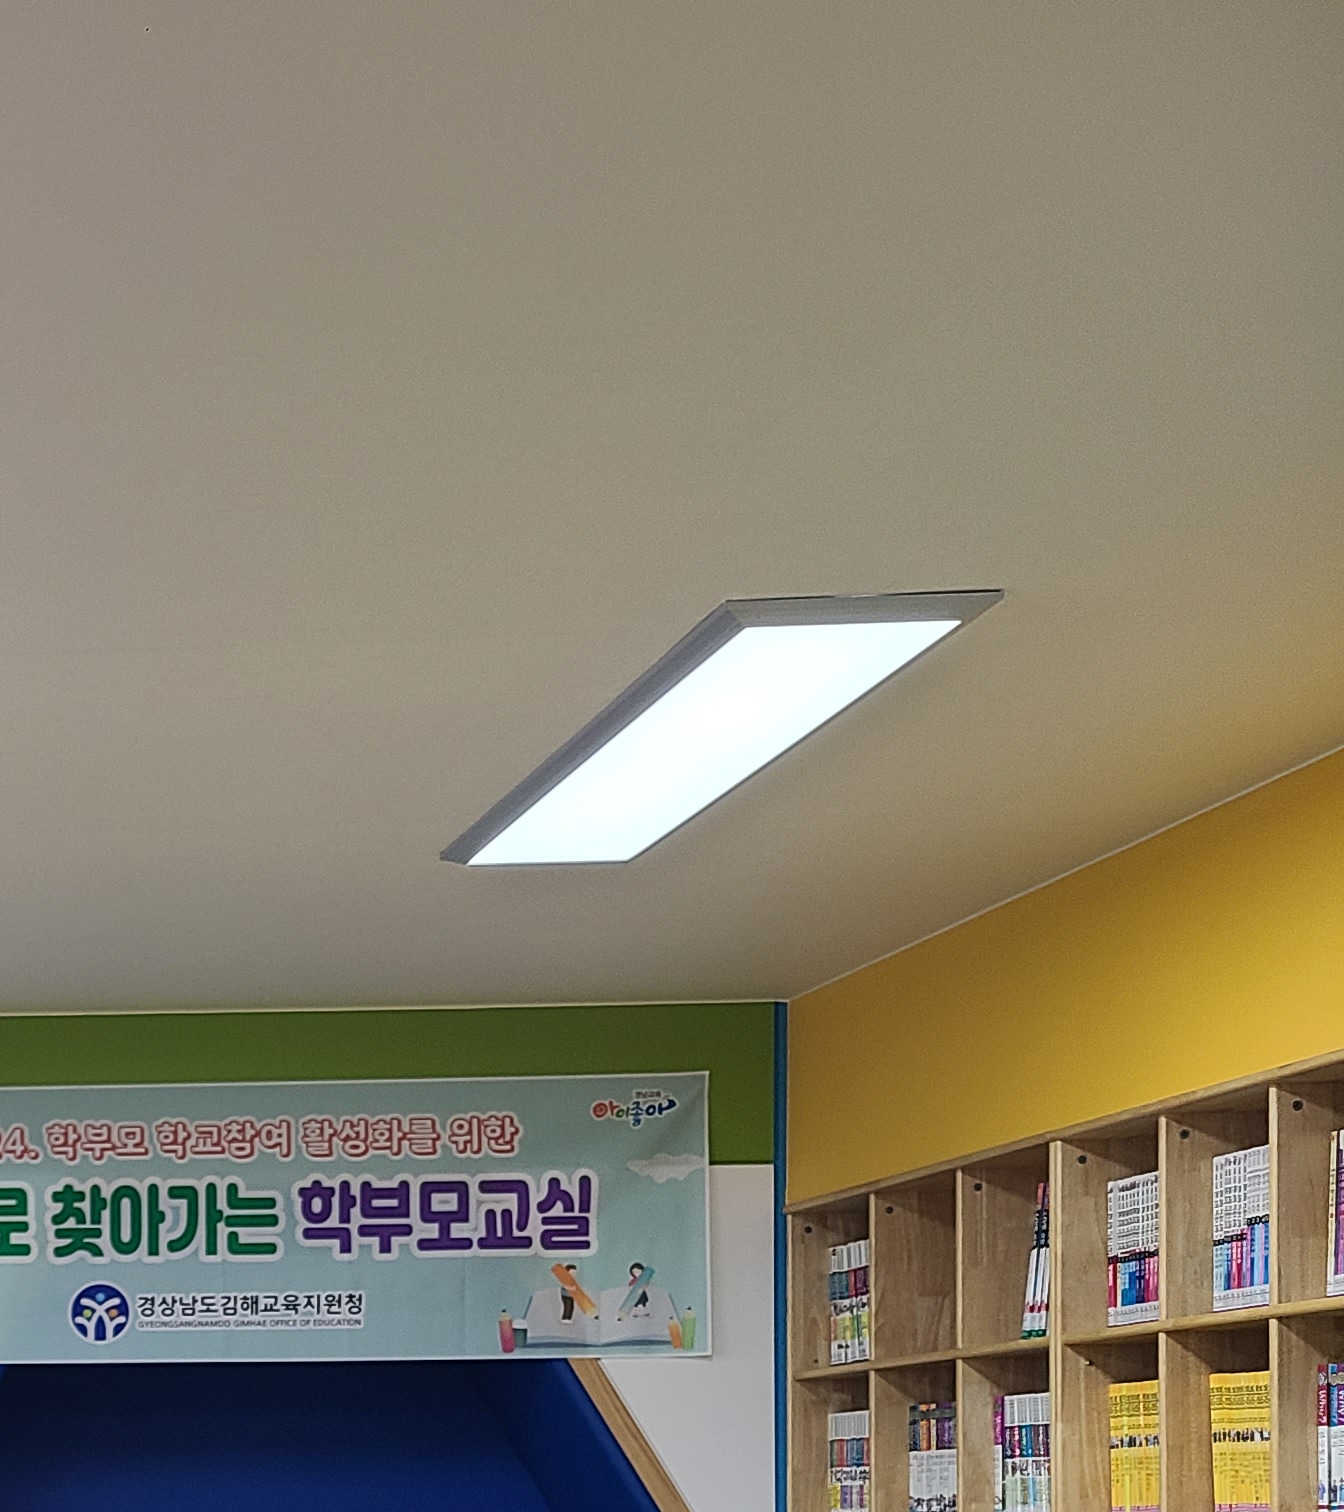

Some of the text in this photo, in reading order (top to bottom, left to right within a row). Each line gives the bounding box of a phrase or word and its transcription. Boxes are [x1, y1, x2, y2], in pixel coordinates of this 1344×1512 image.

[592, 1098, 677, 1127] 아이좋아
[45, 1121, 149, 1162] 학부모
[155, 1118, 292, 1161] 학교참여
[301, 1116, 441, 1158] 활성화를
[448, 1115, 519, 1155] 위한
[50, 1181, 279, 1258] 찾아가는
[297, 1174, 592, 1255] 학부모교실
[136, 1293, 364, 1318] 경상남도김해교육지원청
[137, 1318, 363, 1329] GYEONGSANGNAMDO GIMHAE OFFICE OF EDUCATION
